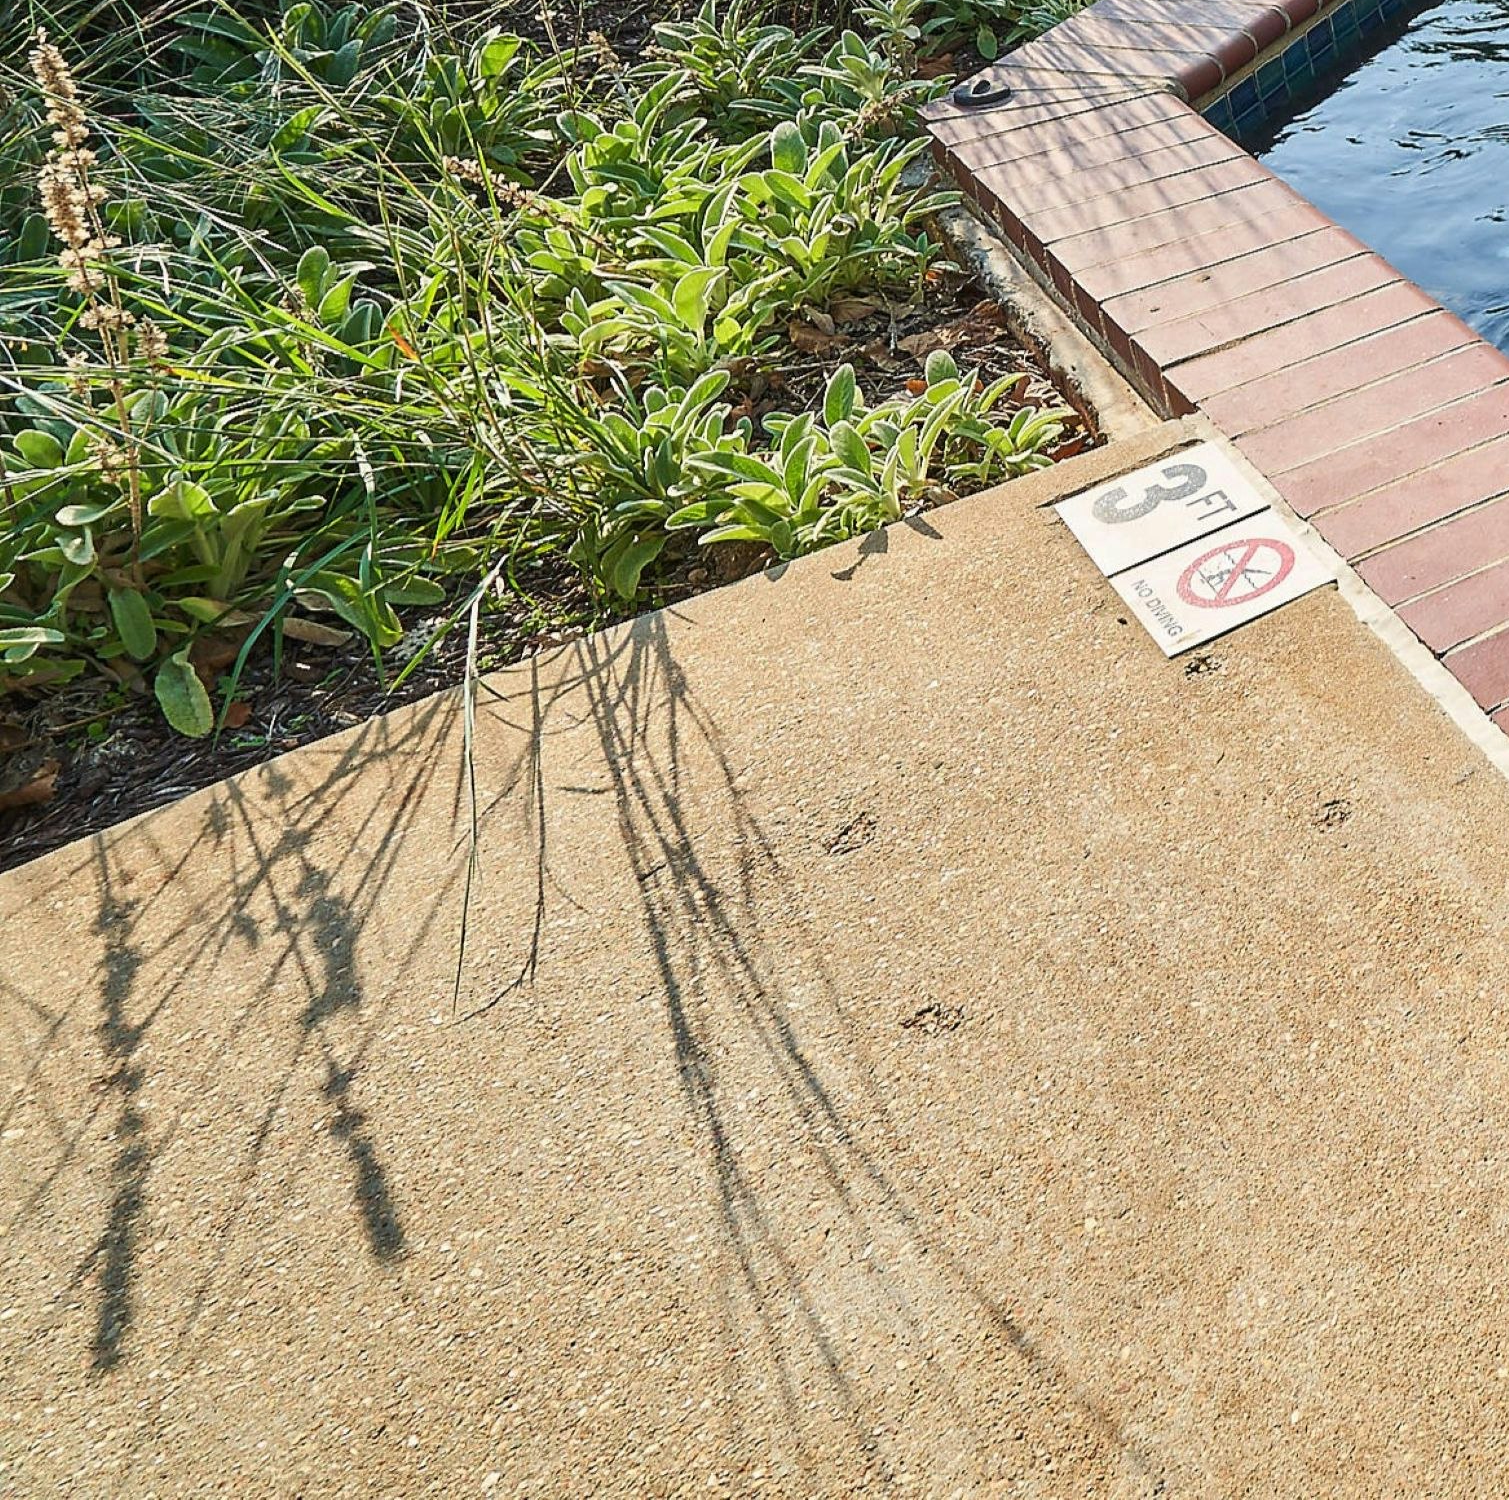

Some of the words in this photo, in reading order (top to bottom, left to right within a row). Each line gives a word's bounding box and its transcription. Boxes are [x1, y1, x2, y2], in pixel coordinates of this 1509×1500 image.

[1092, 463, 1208, 524] 3
[1186, 490, 1238, 521] FT
[1132, 579, 1154, 599] NO
[1145, 598, 1184, 638] DIVING
